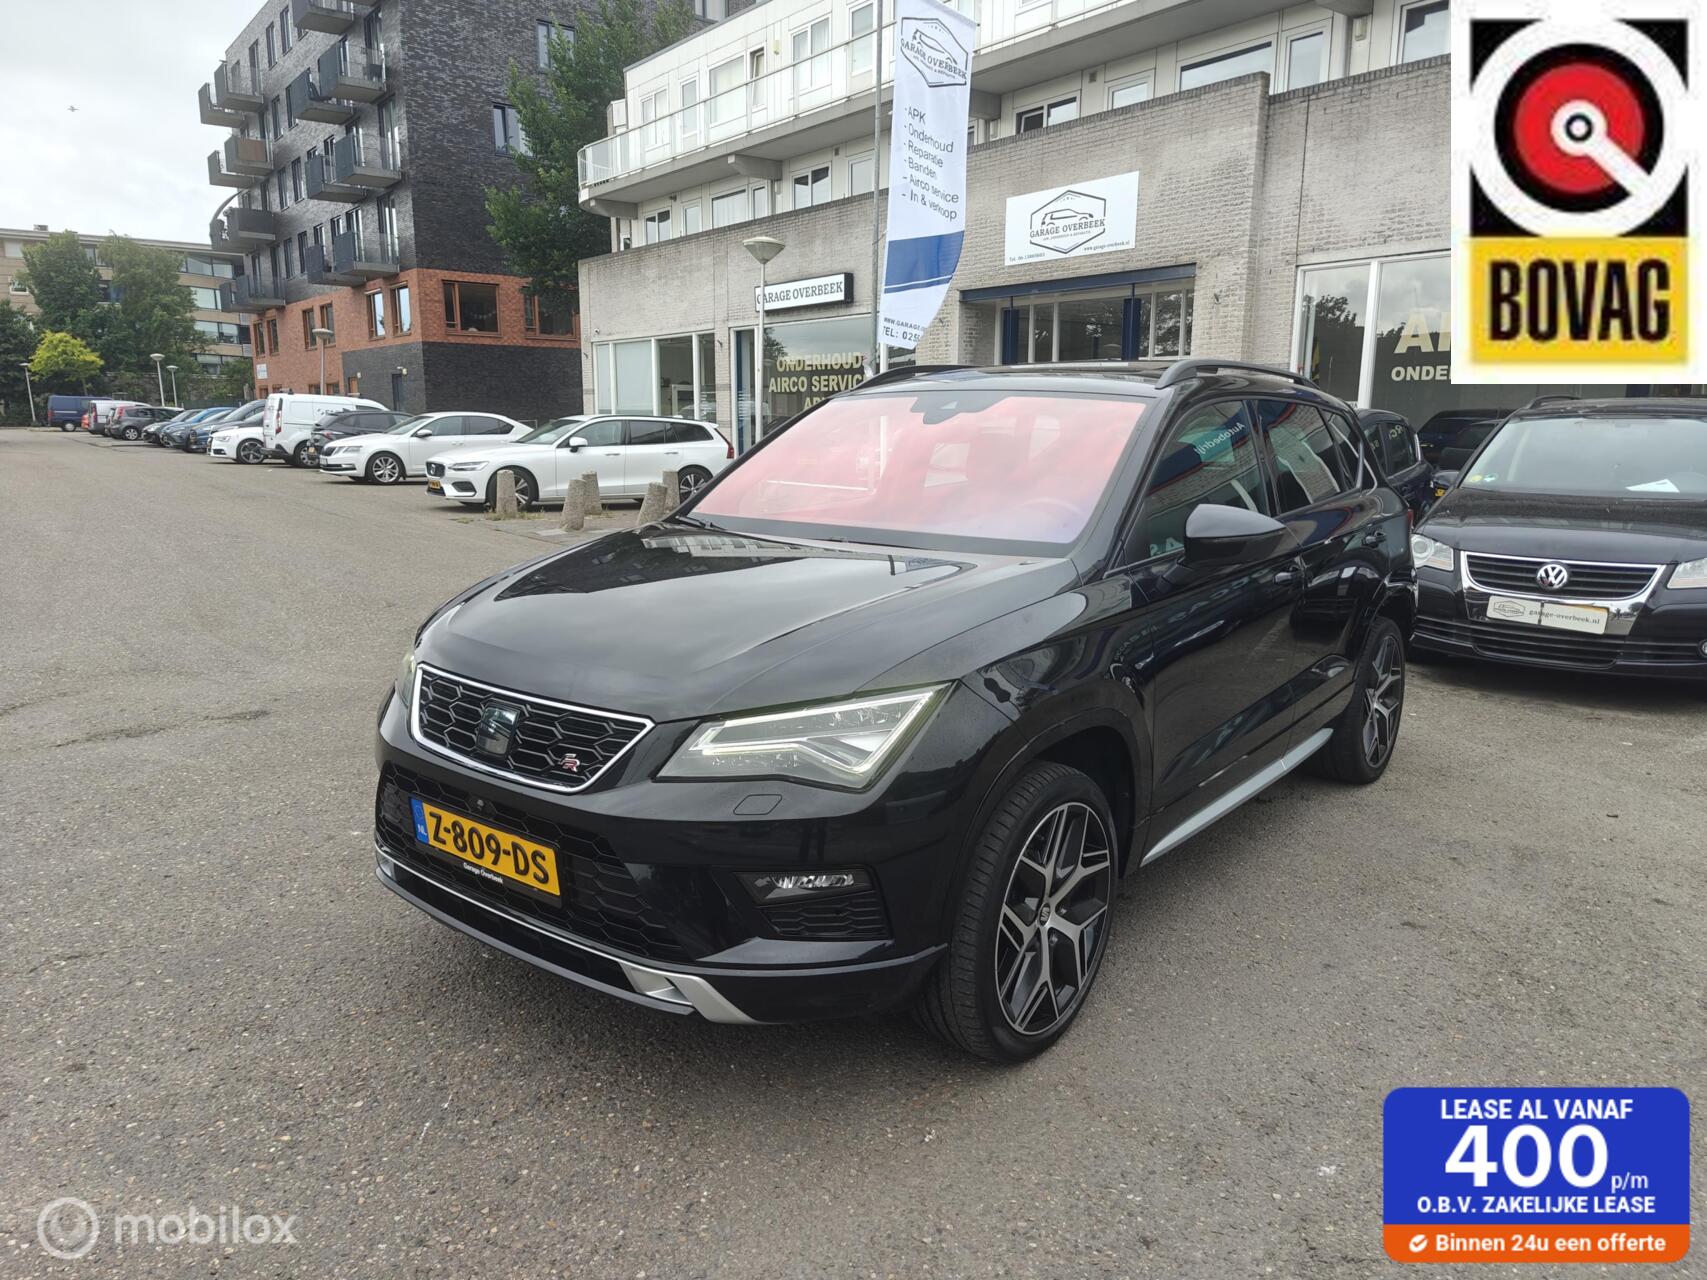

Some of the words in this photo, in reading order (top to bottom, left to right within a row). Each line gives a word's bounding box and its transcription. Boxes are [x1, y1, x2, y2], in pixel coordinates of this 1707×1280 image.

[927, 56, 967, 79] OVERBEEK
[908, 106, 926, 125] APK
[908, 122, 954, 153] Onderhoud
[909, 174, 930, 192] Airco
[910, 189, 919, 203] In
[920, 193, 927, 206] &
[1029, 226, 1060, 239] GARAGE
[1062, 218, 1106, 233] OVERBEEK
[793, 282, 844, 300] OVERBEEK
[776, 352, 862, 372] ONDERHOUD
[1391, 365, 1451, 382] ONDE
[768, 376, 808, 393] AIRCO
[429, 811, 550, 884] Z-809-DS
[463, 862, 481, 875] Garage
[480, 868, 504, 885] Overbeek
